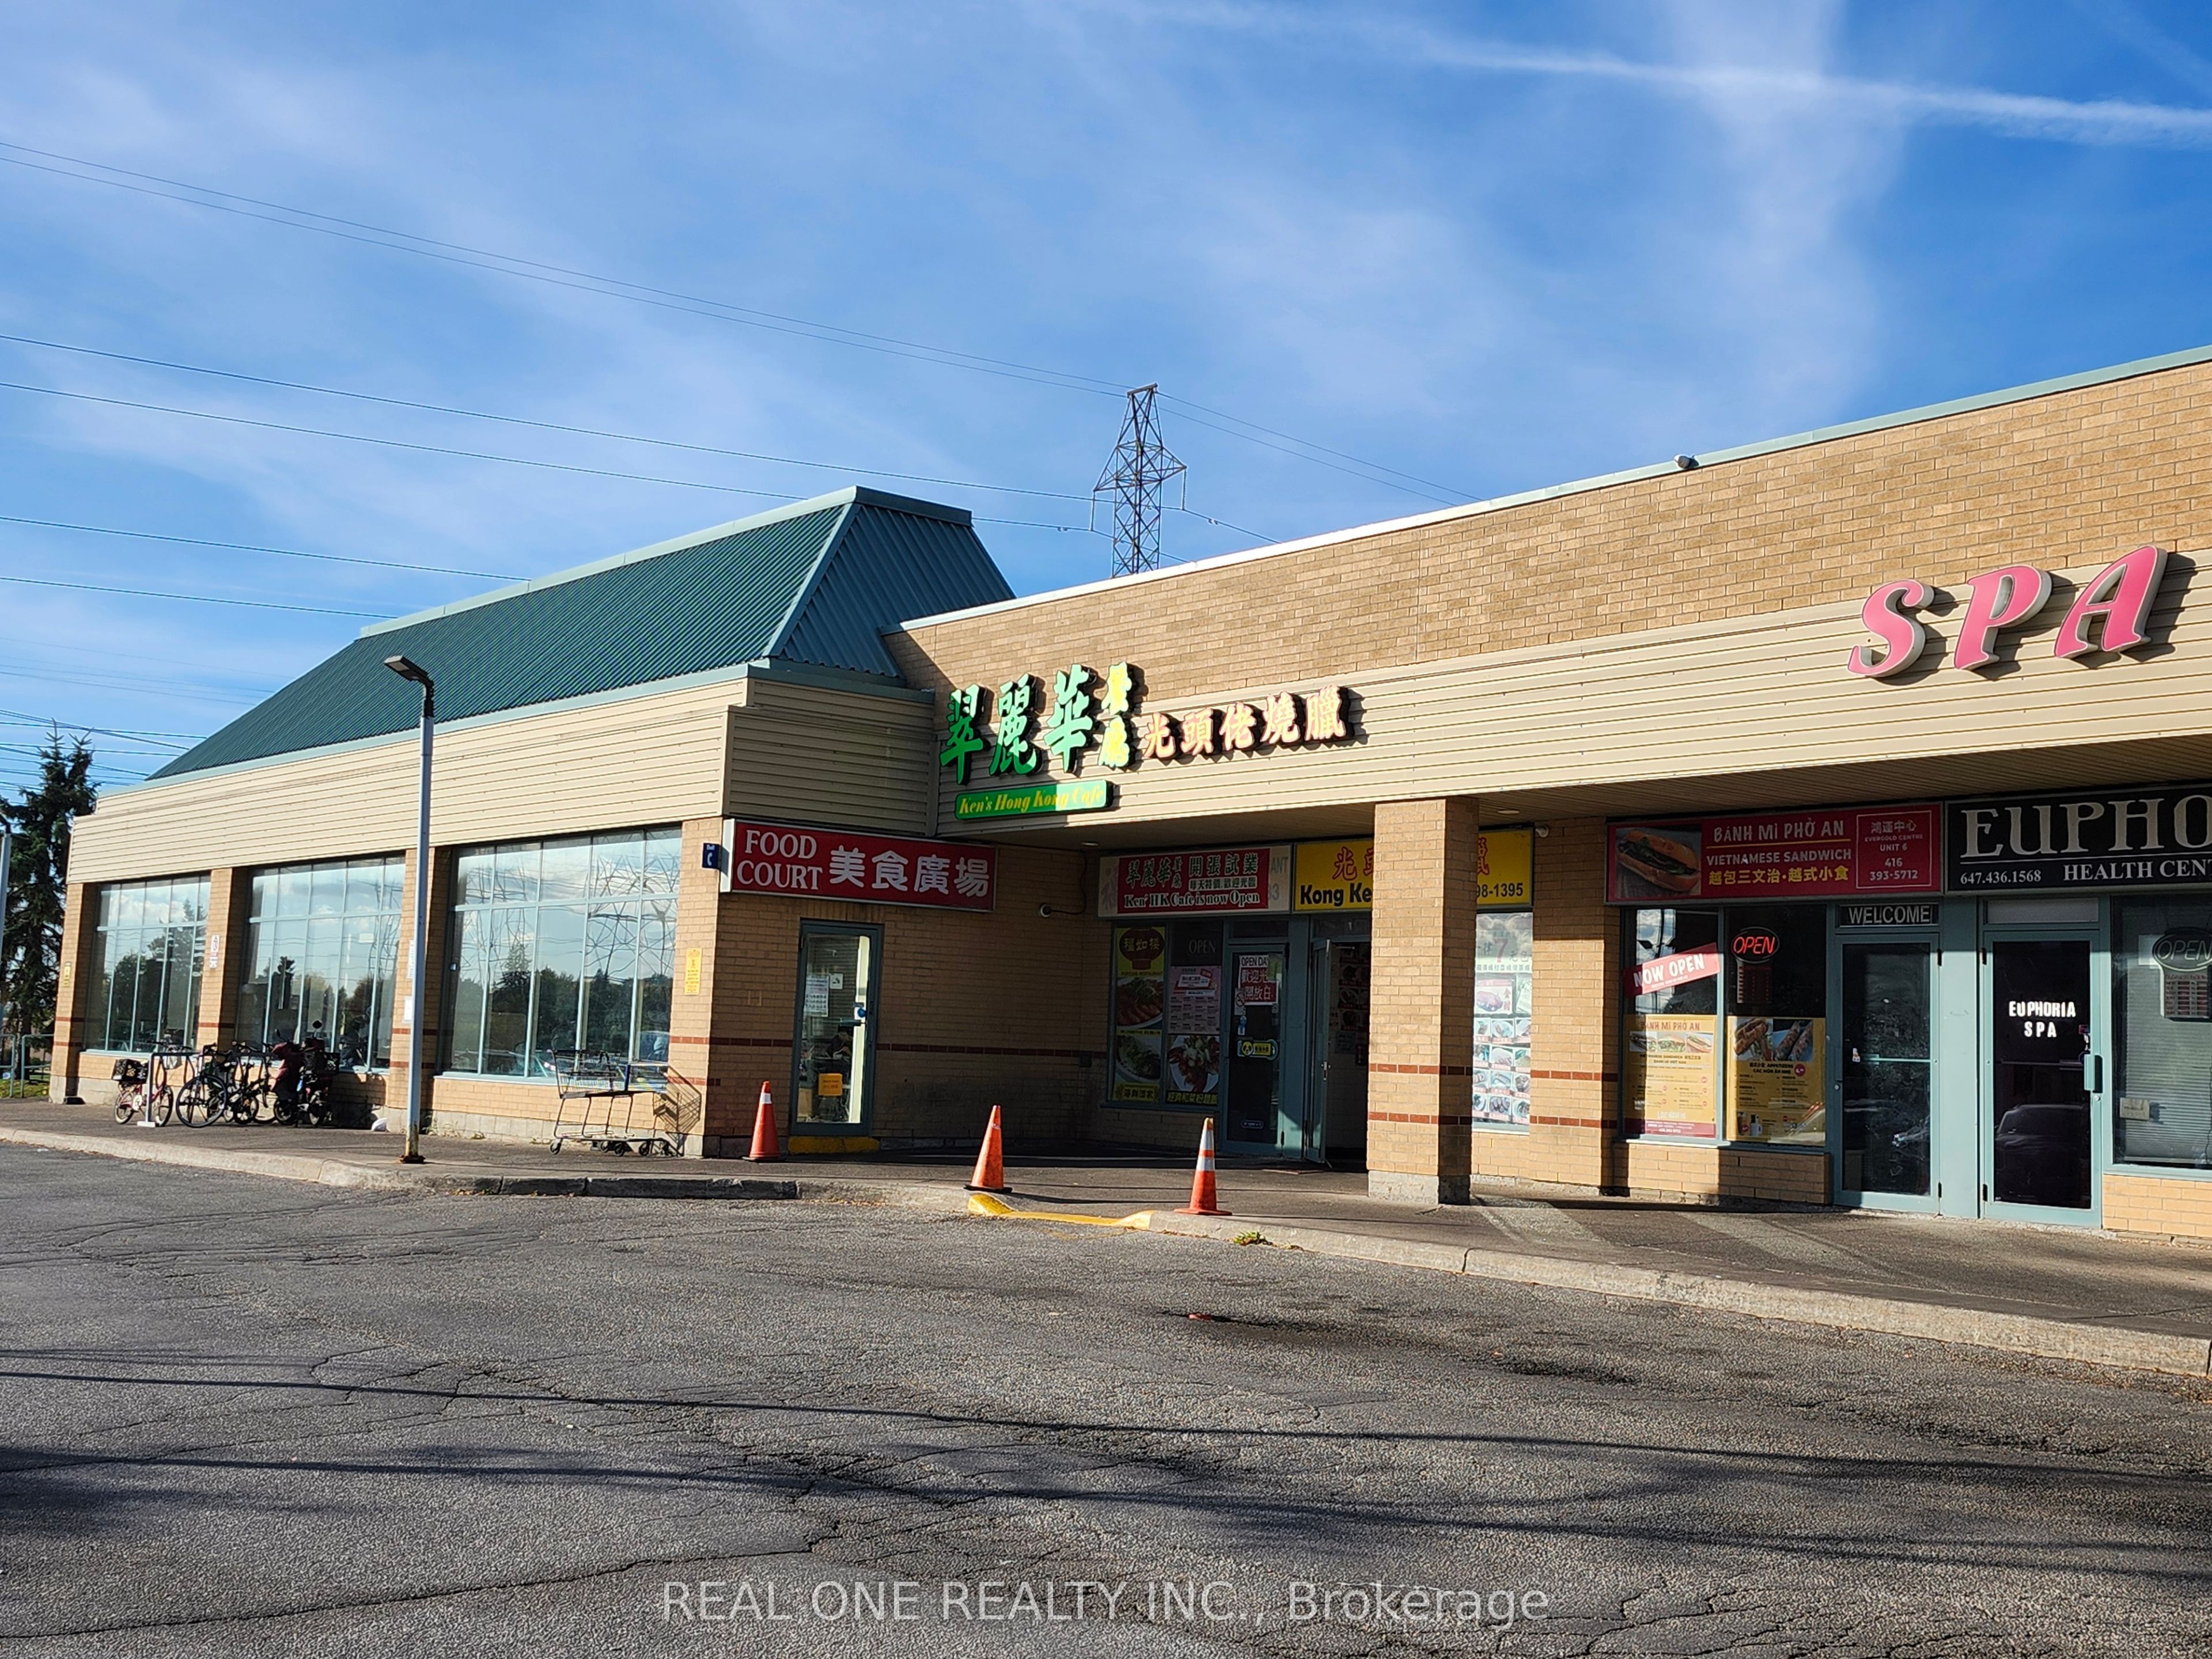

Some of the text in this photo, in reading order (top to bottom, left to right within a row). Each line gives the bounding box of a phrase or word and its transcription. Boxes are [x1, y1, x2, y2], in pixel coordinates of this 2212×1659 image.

[1847, 544, 2168, 678] SPA
[959, 796, 993, 815] Ken's
[994, 793, 1031, 813] Hong
[1033, 789, 1070, 808] Kong
[1821, 820, 1844, 836] AN
[744, 830, 817, 859] FOOD
[1880, 843, 1908, 852] UNIT 6
[1188, 853, 1259, 878] 開張試業
[1706, 848, 1852, 866] VIETNAMESE SANDWICH
[1884, 857, 1903, 868] 416
[737, 860, 823, 891] COURT
[829, 844, 990, 898] 美食廣場
[1870, 870, 1918, 881] 393-5712
[1960, 870, 2042, 885] 647.436.1568
[2063, 861, 2154, 882] HEALTH
[1149, 892, 1171, 908] HK
[1170, 891, 1195, 907] Cafe
[1195, 891, 1206, 906] is
[1206, 893, 1229, 906] now
[1229, 889, 1261, 908] Open
[1300, 884, 1344, 907] Kong
[1849, 904, 1931, 925] WELCOME
[1188, 940, 1217, 955] OPEN
[1733, 935, 1776, 955] OPEN
[2157, 940, 2212, 961] OPEN
[1241, 957, 1268, 967] OPEN DA
[1633, 964, 1664, 988] NOW
[1668, 953, 1705, 978] OPEN
[2008, 1000, 2077, 1018] EUPHORIA
[1689, 1022, 1700, 1031] AN
[2023, 1020, 2058, 1038] SPA
